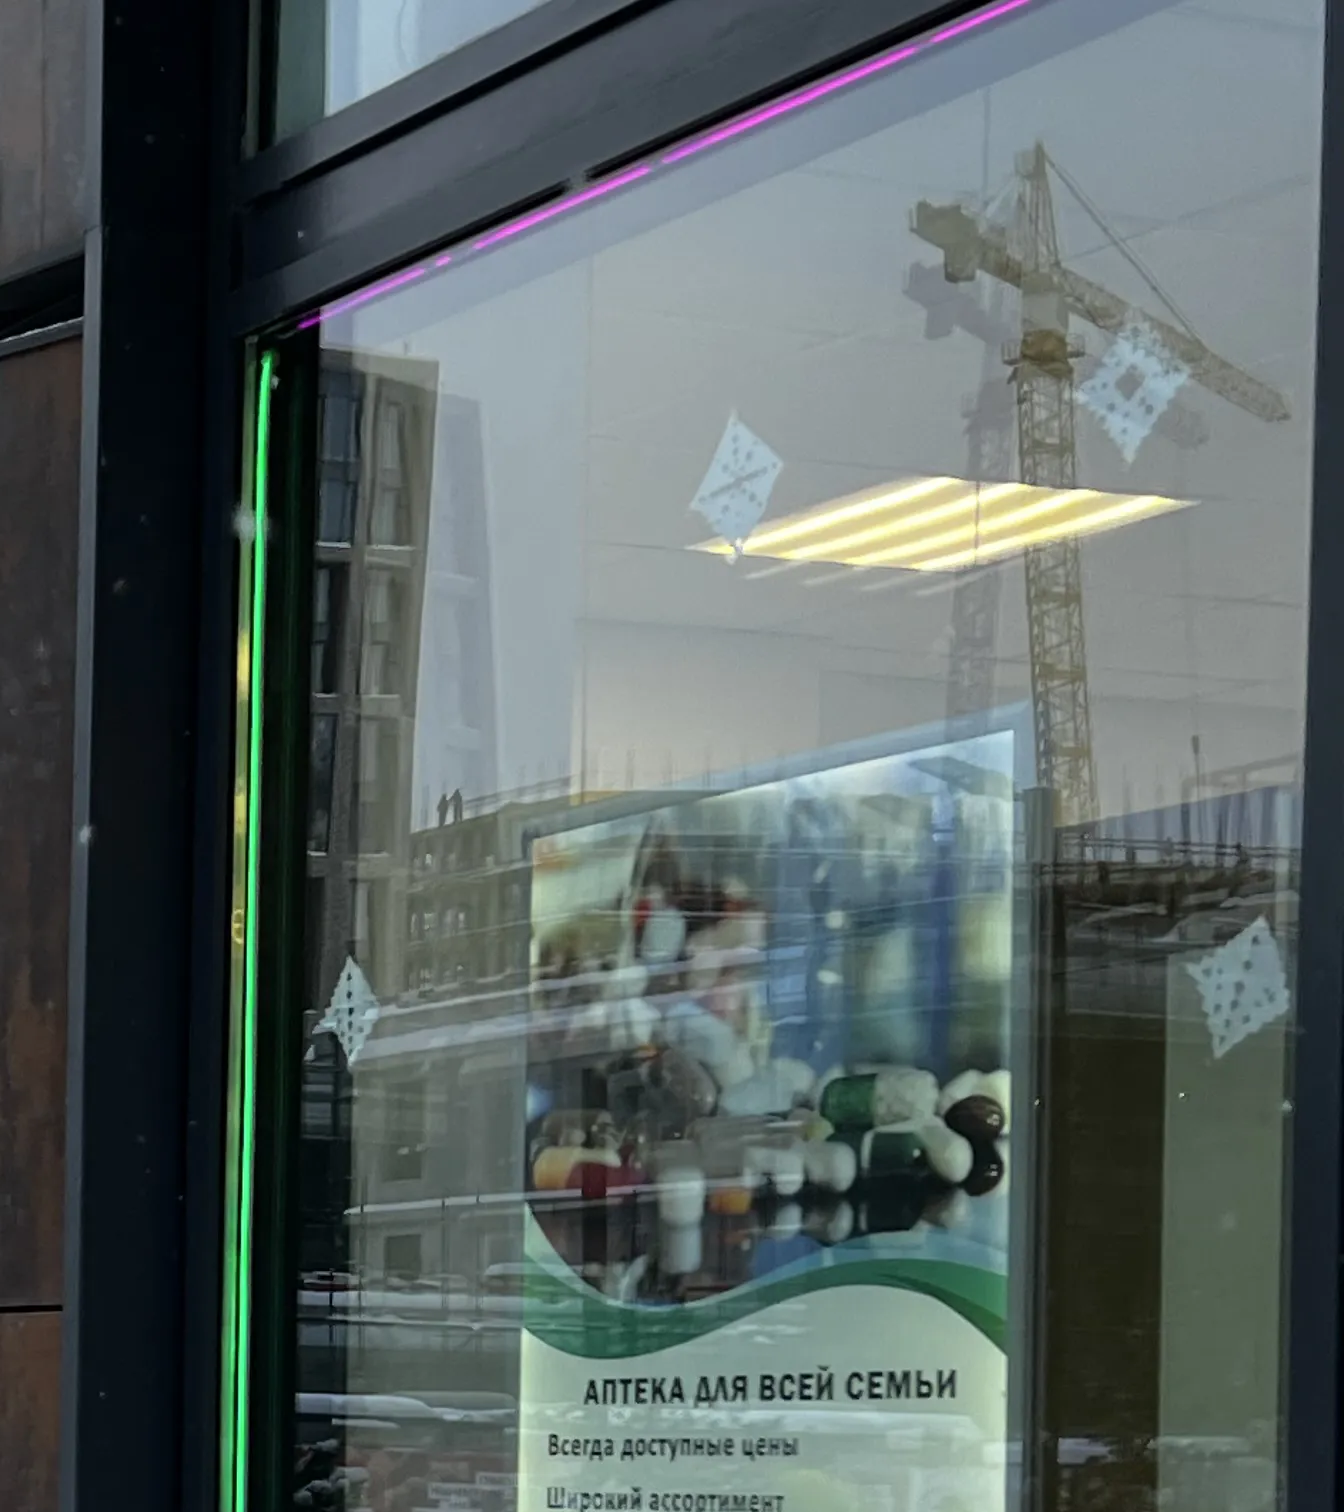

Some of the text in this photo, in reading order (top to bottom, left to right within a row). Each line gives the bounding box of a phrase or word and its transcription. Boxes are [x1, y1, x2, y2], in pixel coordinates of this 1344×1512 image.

[584, 1365, 957, 1408] АПТЕКА ДЛЯ ВСЕЙ СЕМЬИ
[548, 1433, 799, 1462] Всегда доступные цены
